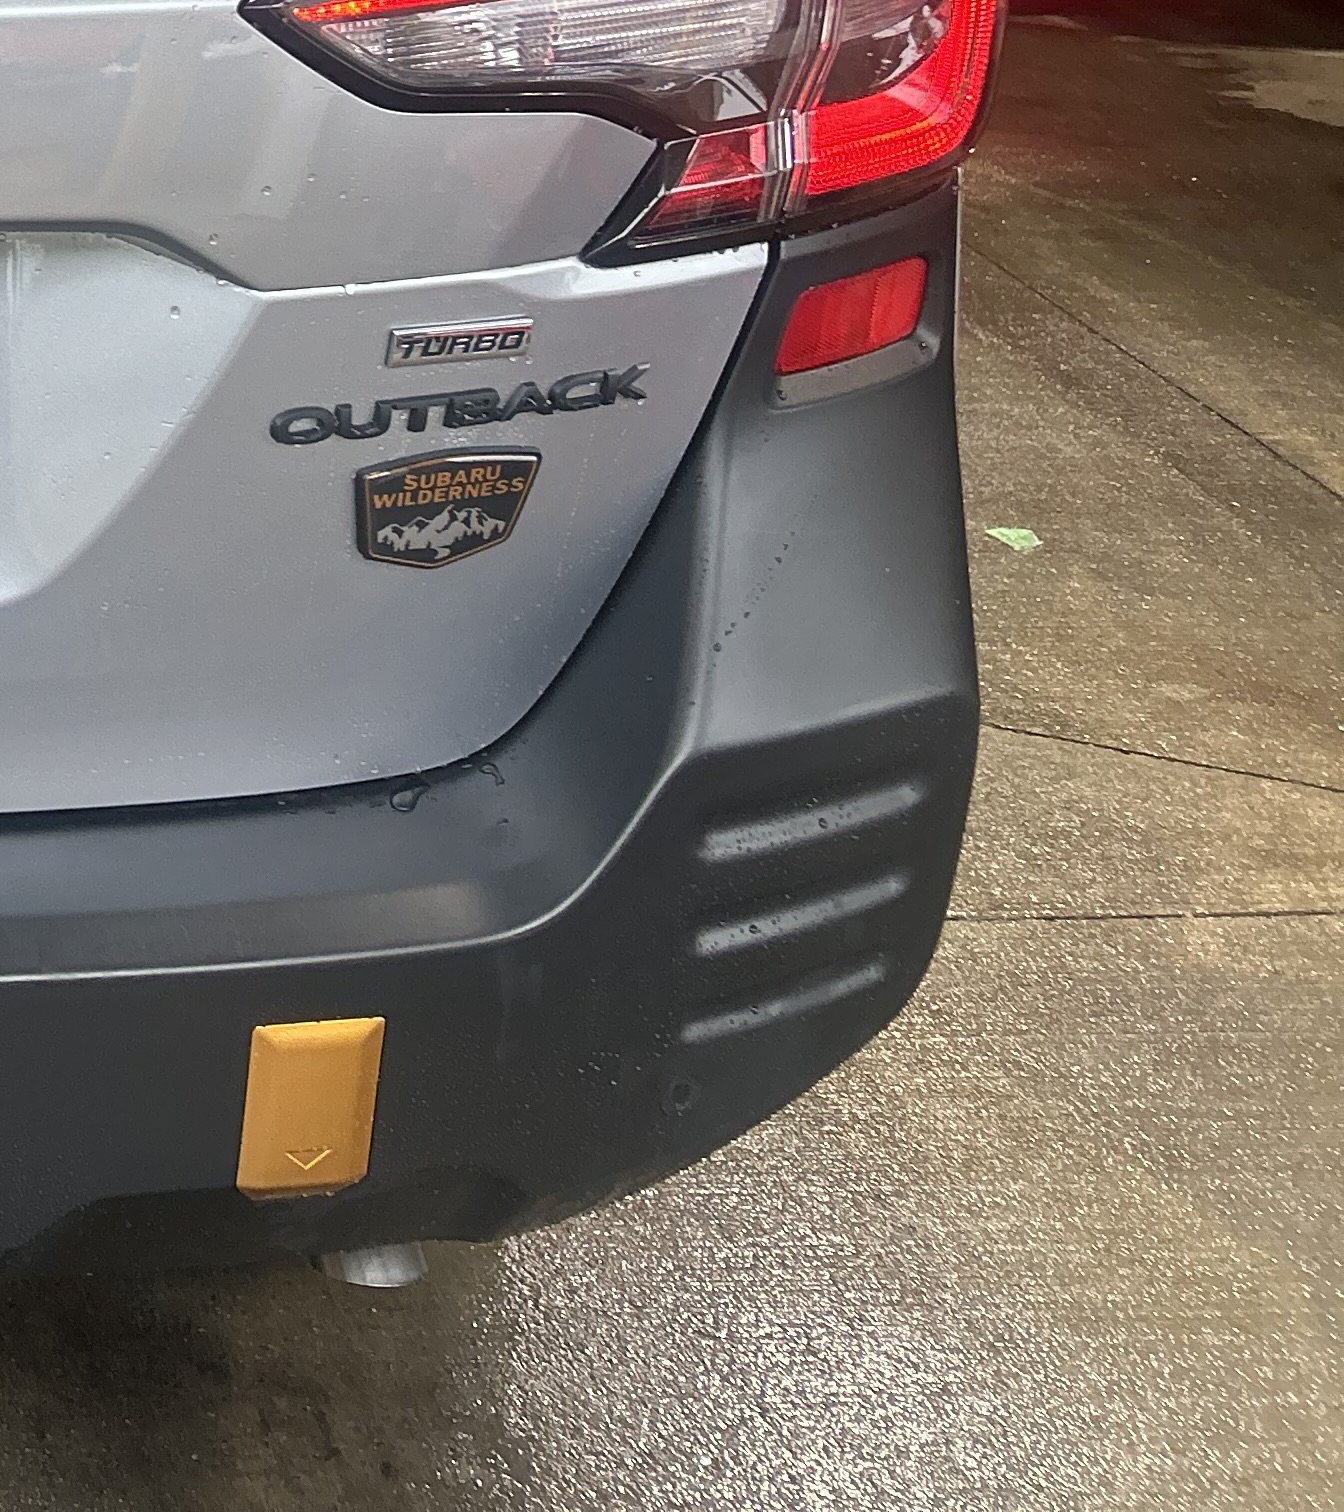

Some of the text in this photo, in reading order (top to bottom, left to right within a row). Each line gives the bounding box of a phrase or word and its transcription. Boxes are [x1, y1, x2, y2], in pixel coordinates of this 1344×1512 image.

[399, 329, 526, 360] TURBO
[269, 361, 652, 445] OUTBACK
[373, 477, 527, 509] WILDERNESS
[403, 464, 502, 491] SUBARU
